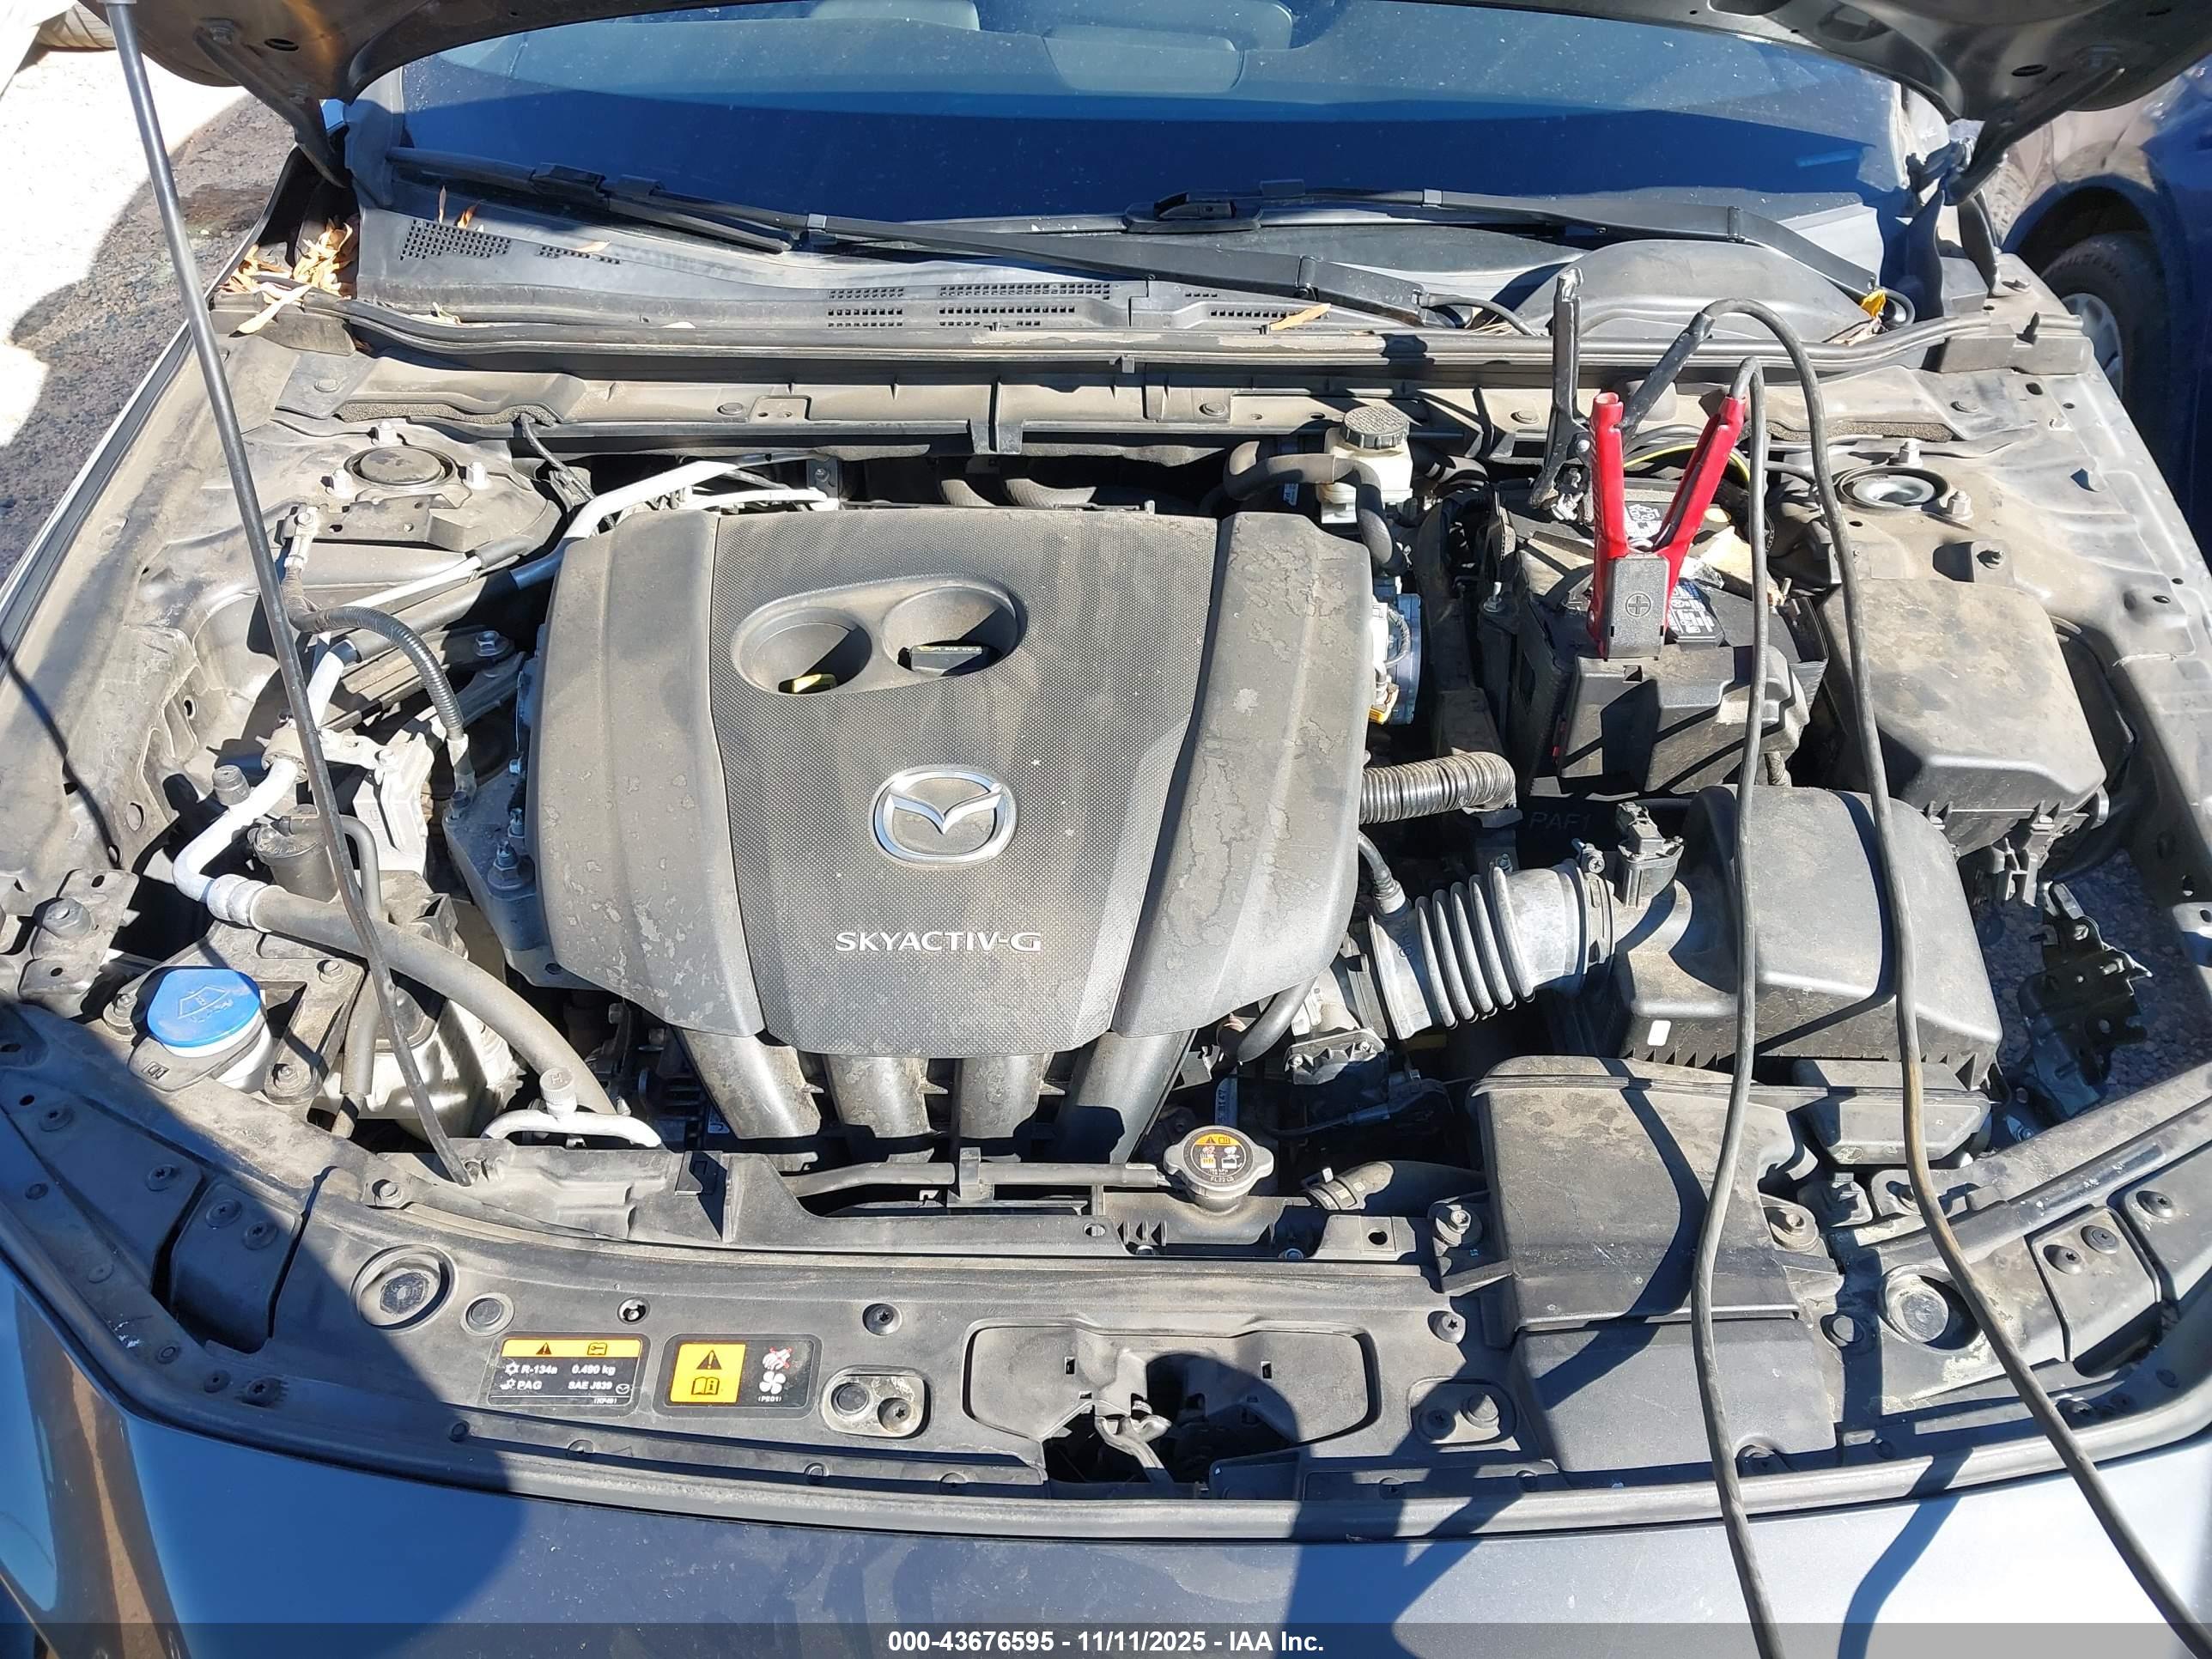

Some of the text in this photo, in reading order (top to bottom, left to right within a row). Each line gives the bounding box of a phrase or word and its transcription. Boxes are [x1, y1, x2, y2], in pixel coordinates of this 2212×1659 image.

[834, 931, 1041, 952] SKYACTIV-G
[520, 1364, 557, 1375] R-134a
[601, 1364, 617, 1376] kg
[517, 1380, 543, 1390] PAG
[568, 1381, 590, 1390] SAE
